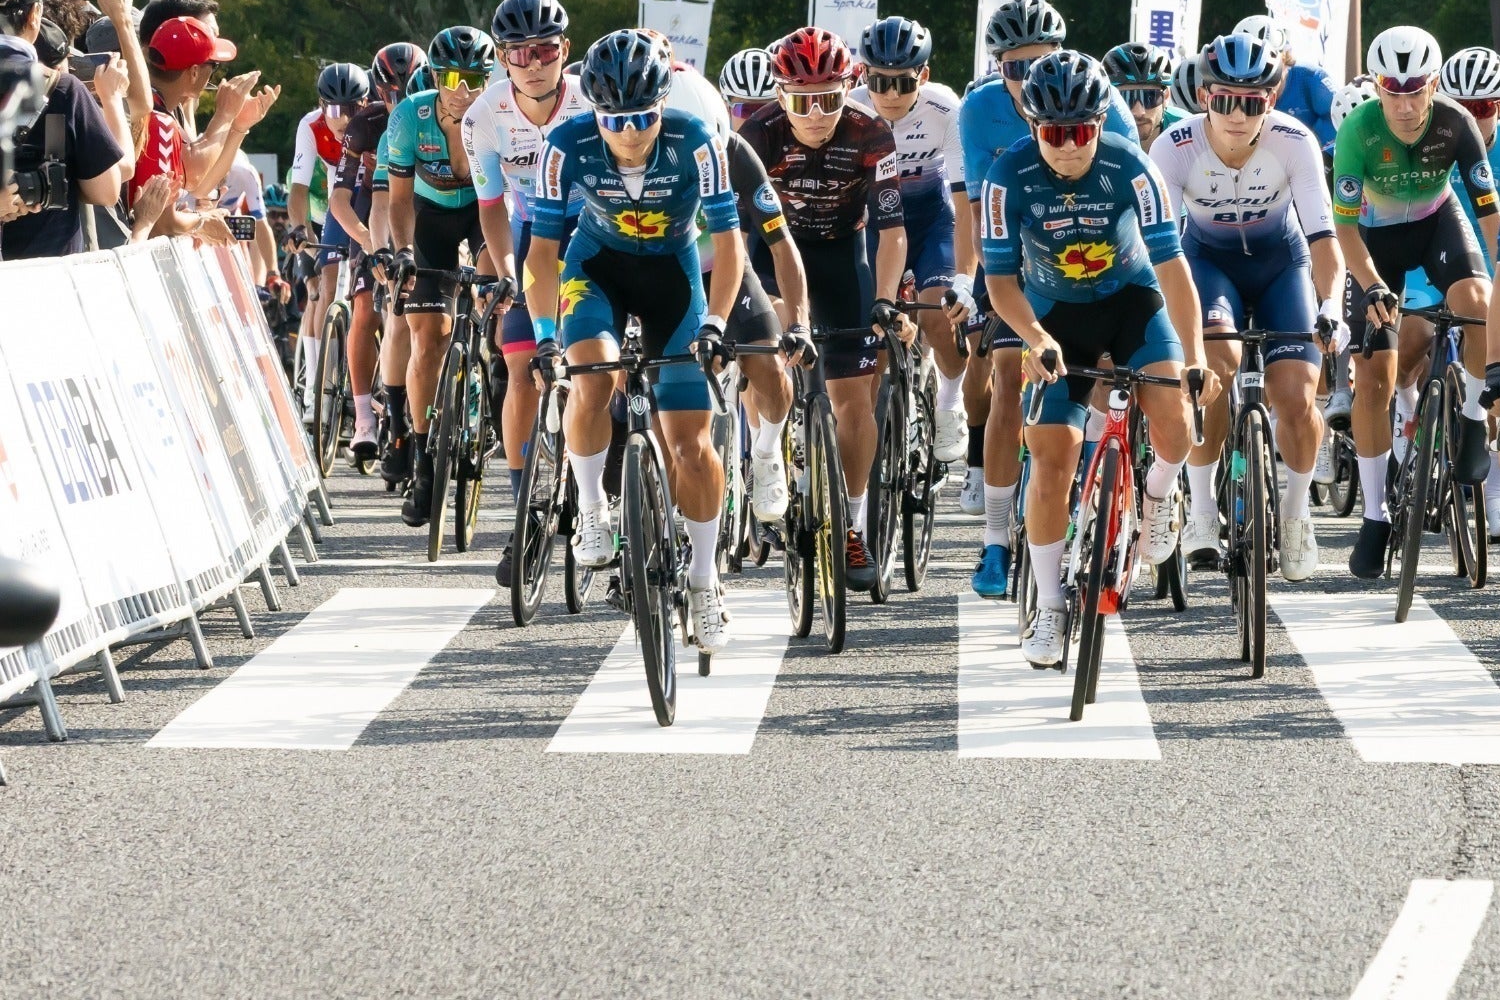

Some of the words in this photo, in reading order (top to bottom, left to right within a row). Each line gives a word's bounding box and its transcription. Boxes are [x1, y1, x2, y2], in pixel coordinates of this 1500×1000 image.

[1170, 126, 1193, 143] BH
[879, 158, 896, 171] you
[882, 166, 896, 176] me
[1213, 208, 1268, 222] BH
[1245, 377, 1261, 385] BH
